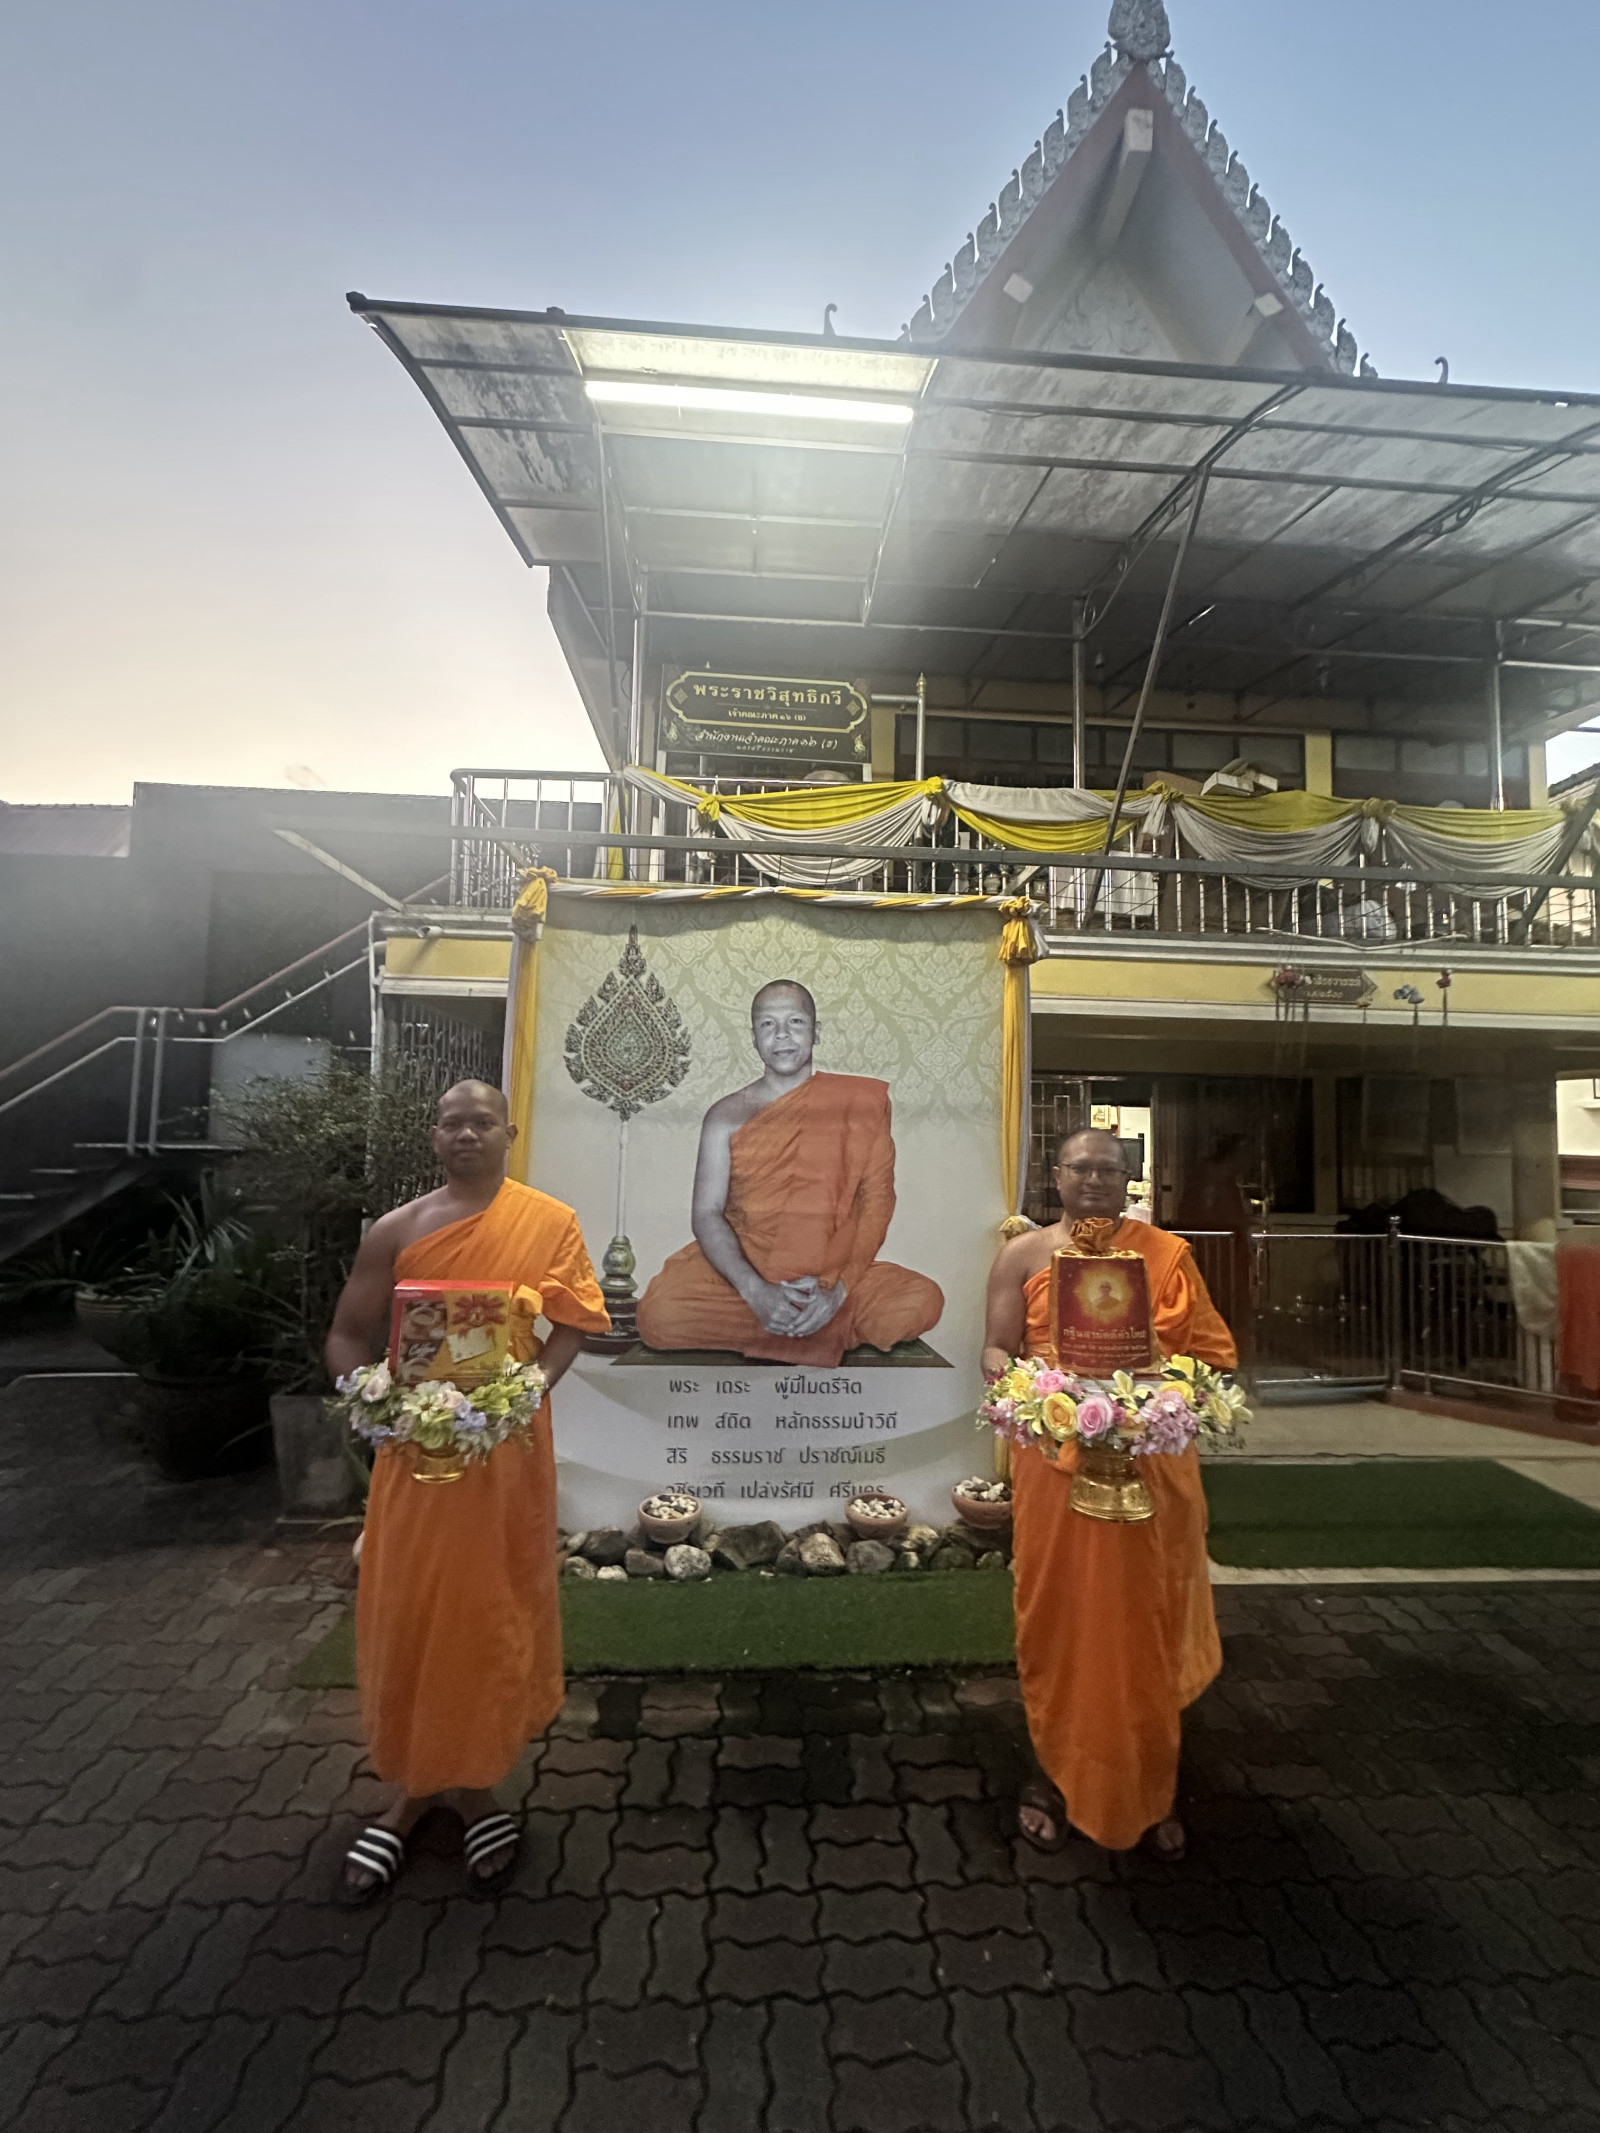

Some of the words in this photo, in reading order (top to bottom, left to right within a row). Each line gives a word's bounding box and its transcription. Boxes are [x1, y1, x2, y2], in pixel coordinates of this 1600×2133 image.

[693, 683, 842, 707] พระราชวิสุทธิกวี
[669, 1380, 699, 1394] พระ
[716, 1380, 750, 1394] เถระ
[775, 1375, 862, 1399] ผู้มีไมตรีจิต
[667, 1415, 698, 1429] เทพ
[715, 1412, 750, 1429] สถิต
[776, 1411, 898, 1429] หลักธรรมนำวิถี
[666, 1447, 688, 1464] สิริ
[711, 1447, 786, 1464] ธรรมราช
[799, 1445, 885, 1464] ปราชญ์เมธี
[741, 1479, 814, 1498] เปล่งรัศมี
